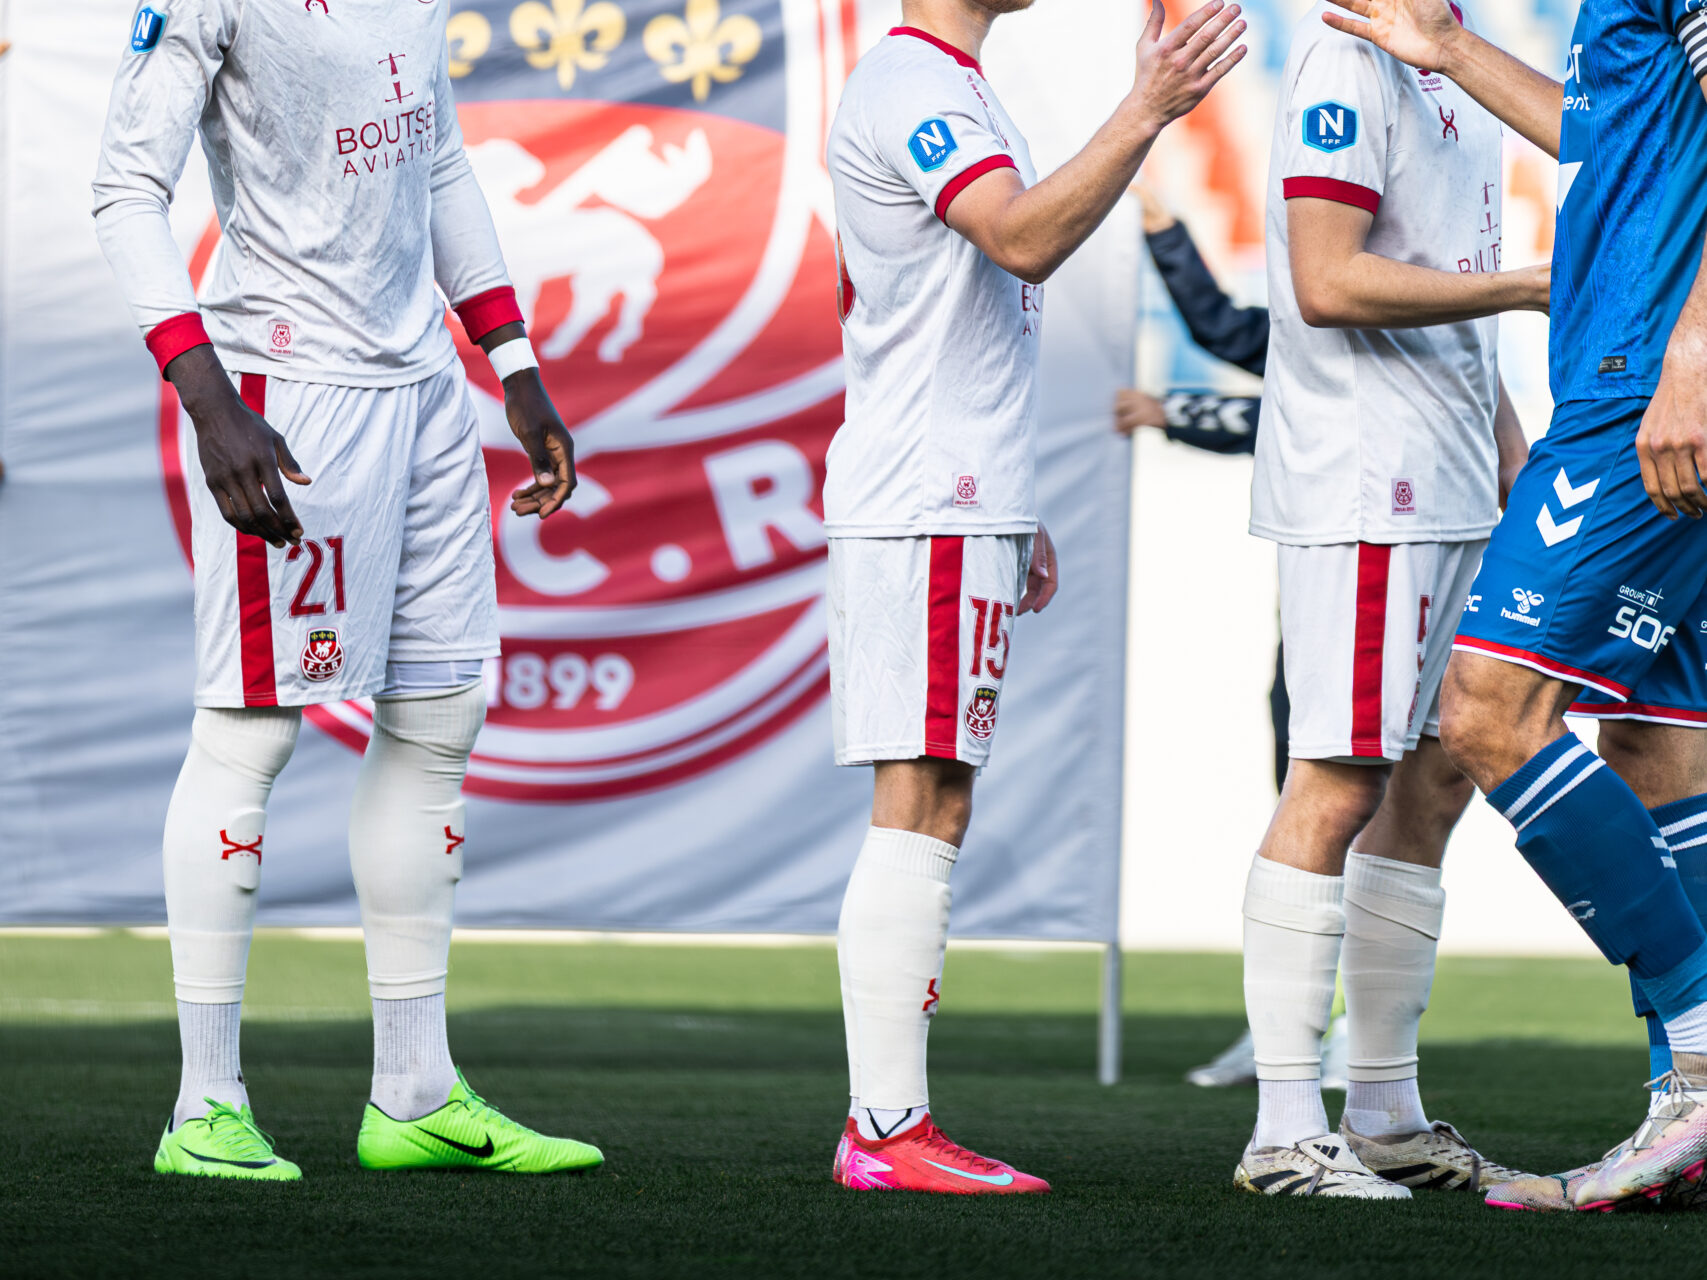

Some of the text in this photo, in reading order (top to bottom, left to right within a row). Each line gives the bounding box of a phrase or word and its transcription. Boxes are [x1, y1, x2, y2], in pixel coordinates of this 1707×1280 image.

[135, 11, 154, 40] N
[336, 100, 435, 155] BOUTSE
[915, 122, 946, 157] N
[1318, 108, 1344, 136] N
[343, 134, 433, 178] AVIATIO
[286, 535, 347, 618] 21
[1619, 584, 1647, 602] GROUPE
[1500, 607, 1541, 627] hummel
[968, 595, 1015, 681] 15
